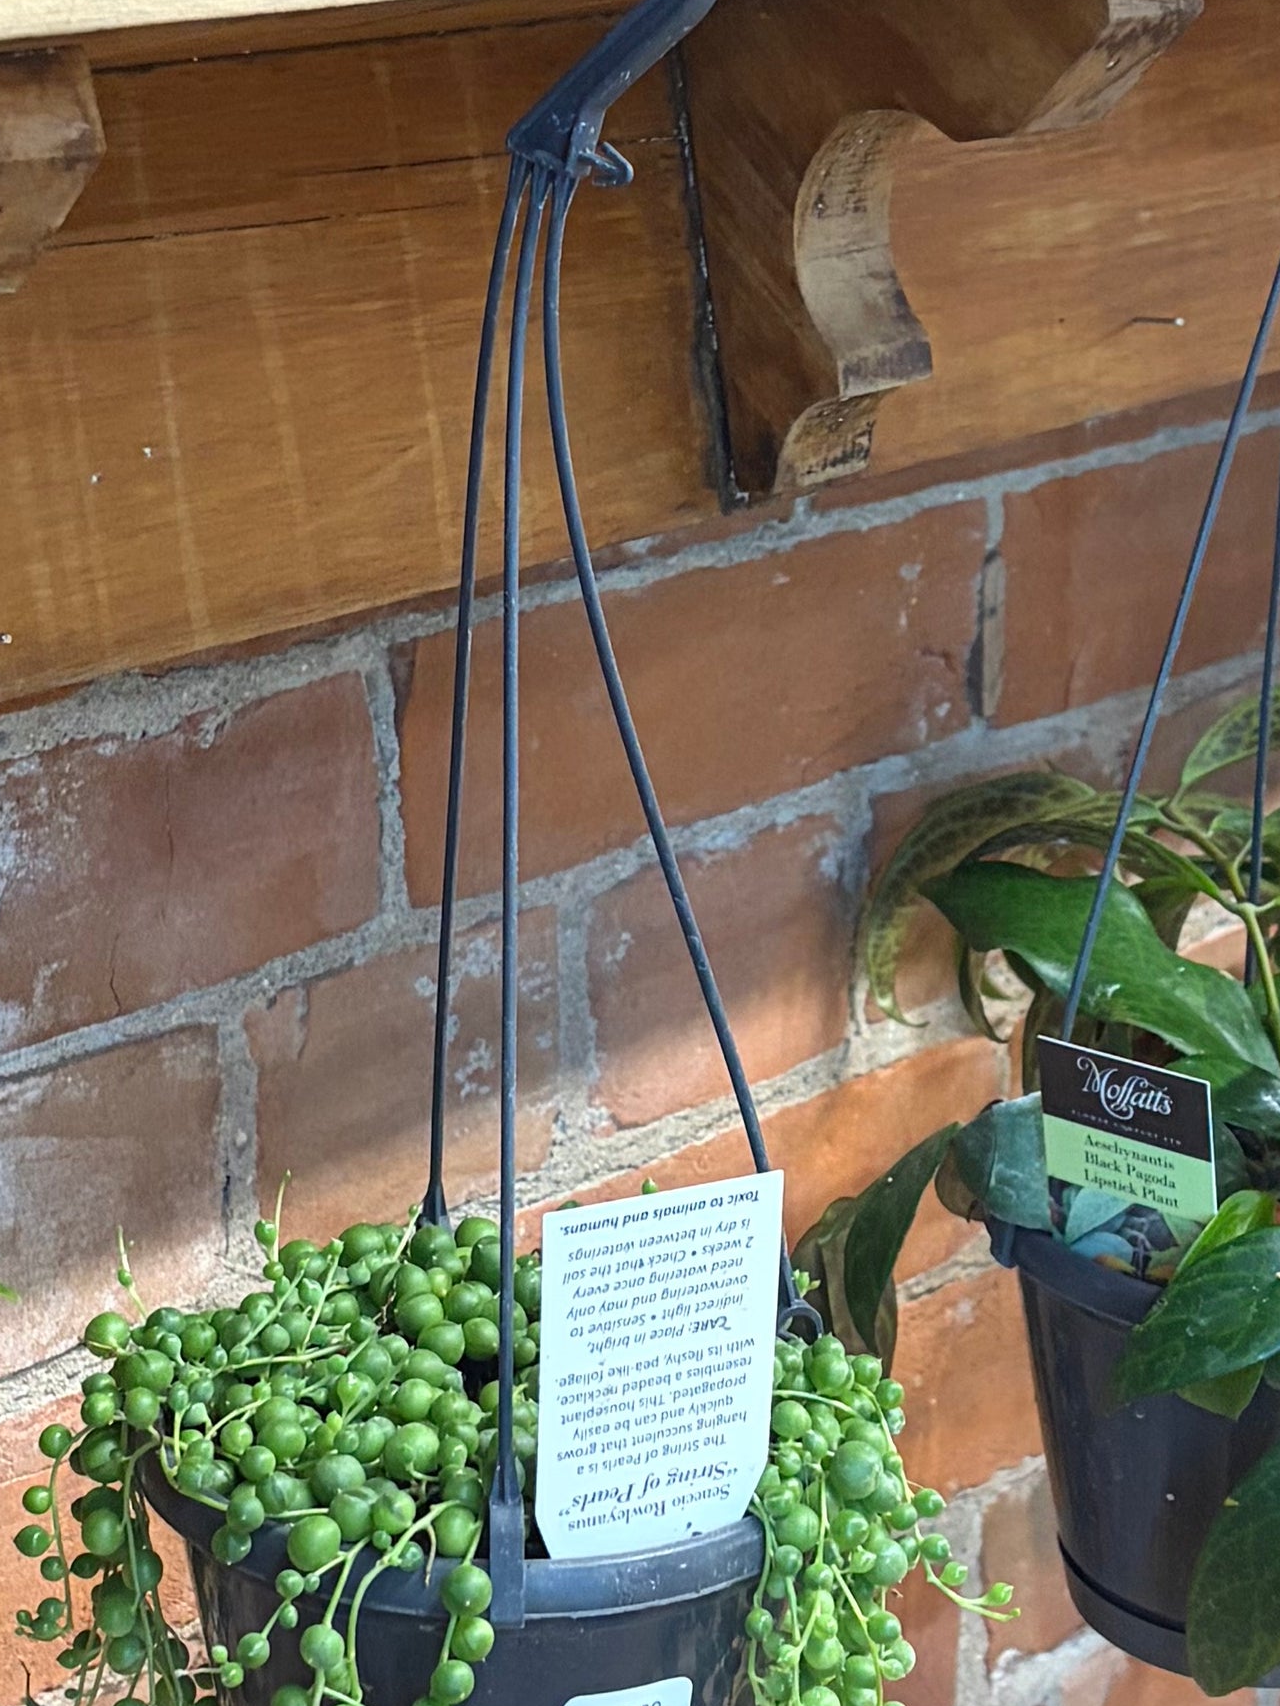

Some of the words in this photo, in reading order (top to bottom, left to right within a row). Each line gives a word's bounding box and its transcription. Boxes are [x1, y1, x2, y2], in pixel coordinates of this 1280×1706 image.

[1085, 1151, 1122, 1174] Black
[1127, 1164, 1176, 1189] Pagoda
[1084, 1169, 1138, 1196] Lipstick
[1142, 1187, 1178, 1208] Plant
[710, 1197, 723, 1209] to
[728, 1190, 759, 1205] Toxic
[623, 1211, 649, 1227] and
[653, 1200, 706, 1221] animals
[560, 1217, 618, 1237] humans.
[700, 1226, 712, 1237] in
[715, 1220, 737, 1235] dry
[741, 1218, 750, 1230] is
[639, 1228, 696, 1249] between
[745, 1236, 754, 1248] 2
[568, 1241, 634, 1263] waterings
[702, 1239, 742, 1256] weeks
[615, 1258, 644, 1274] that
[647, 1250, 686, 1268] Check
[711, 1257, 743, 1274] need
[563, 1268, 586, 1285] soil
[591, 1265, 612, 1278] the
[650, 1264, 707, 1284] watering
[573, 1282, 610, 1299] every
[614, 1276, 645, 1290] once
[661, 1274, 748, 1301] overwatering
[599, 1298, 628, 1314] may
[632, 1293, 657, 1307] and
[696, 1293, 743, 1313] indirect
[566, 1304, 595, 1321] only
[662, 1304, 691, 1320] light
[570, 1326, 584, 1339] to
[588, 1314, 646, 1335] Sensitive
[650, 1324, 684, 1341] Place
[688, 1316, 727, 1333] CARE:
[587, 1335, 630, 1354] bright,
[634, 1332, 646, 1345] in
[727, 1338, 755, 1354] with
[664, 1348, 703, 1366] fleshy,
[708, 1344, 722, 1357] its
[608, 1356, 659, 1378] pea-like
[687, 1356, 751, 1379] resembles
[555, 1370, 603, 1388] foliage.
[622, 1374, 671, 1395] beaded
[676, 1372, 682, 1381] a
[556, 1386, 618, 1407] necklace,
[669, 1374, 746, 1403] propagated.
[639, 1394, 665, 1409] This
[688, 1395, 733, 1416] quickly
[561, 1401, 635, 1425] houseplant
[635, 1413, 656, 1426] can
[661, 1408, 685, 1423] and
[697, 1411, 747, 1430] hanging
[573, 1424, 610, 1441] easily
[615, 1419, 630, 1431] be
[632, 1423, 692, 1446] succulent
[704, 1434, 726, 1448] The
[557, 1442, 597, 1461] grows
[601, 1438, 627, 1452] that
[662, 1439, 699, 1458] String
[603, 1453, 641, 1472] Pearls
[646, 1449, 658, 1463] of
[577, 1466, 584, 1475] a
[588, 1463, 598, 1474] is
[638, 1473, 660, 1499] of
[672, 1484, 730, 1510] Senecio
[568, 1500, 666, 1531] Rowleyanus
